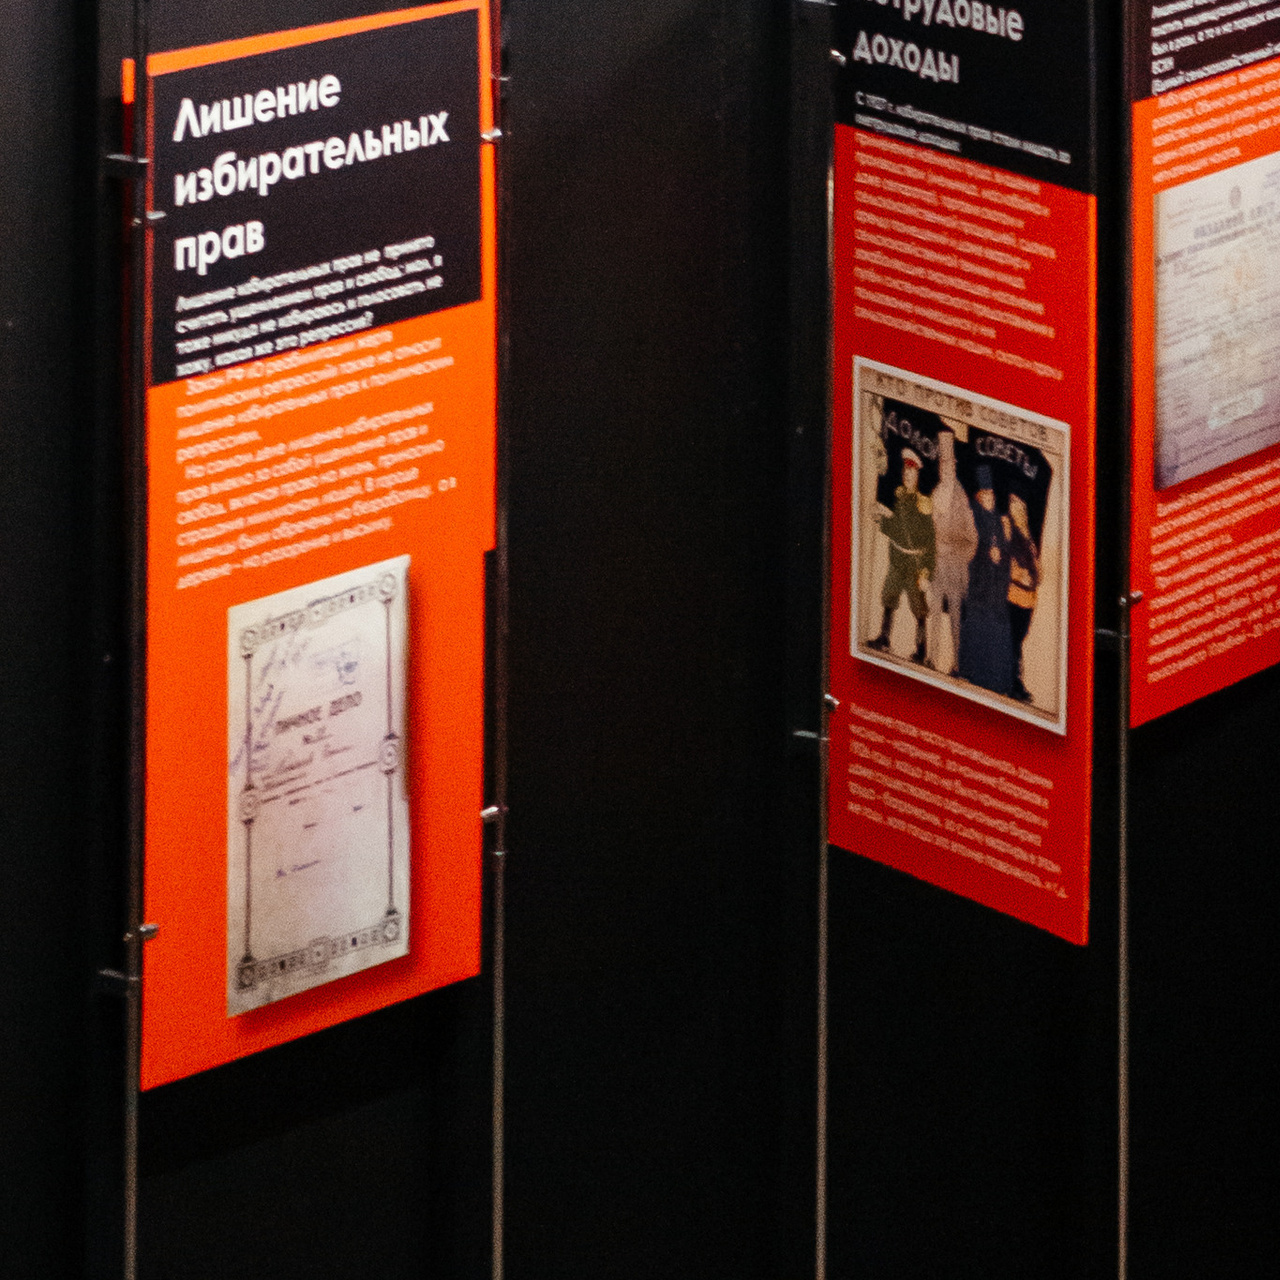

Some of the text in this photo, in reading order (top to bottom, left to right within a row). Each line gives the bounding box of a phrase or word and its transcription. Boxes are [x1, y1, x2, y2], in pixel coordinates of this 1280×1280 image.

[853, 30, 959, 84] доходы
[173, 74, 341, 141] Лишение
[174, 111, 450, 206] избирательных
[174, 220, 265, 275] прав
